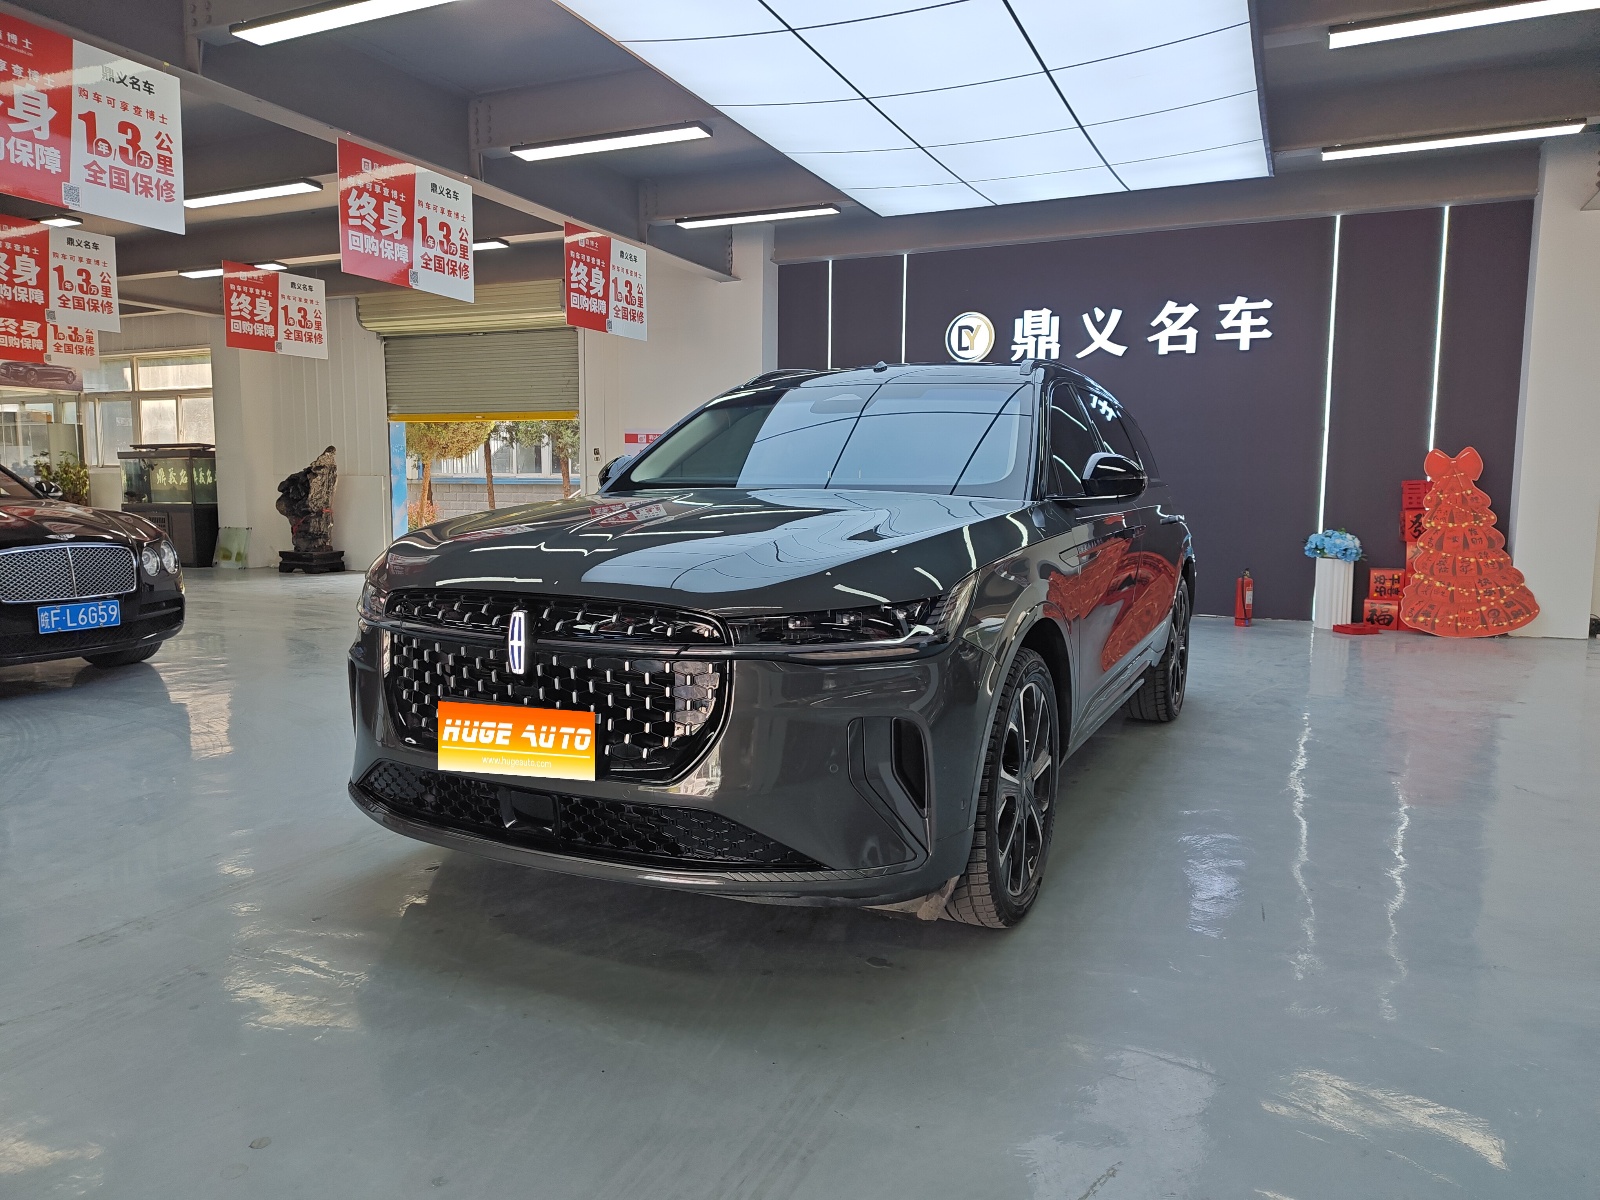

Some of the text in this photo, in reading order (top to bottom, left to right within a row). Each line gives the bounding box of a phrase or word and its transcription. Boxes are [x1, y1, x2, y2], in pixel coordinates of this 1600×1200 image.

[0, 83, 57, 141] 身
[78, 87, 168, 126] 购车可享查博士
[0, 135, 62, 175] 保障
[83, 160, 176, 203] 全国保修
[430, 182, 460, 201] 鼎义名车
[347, 189, 407, 240] 终身
[348, 229, 410, 264] 回购保障
[420, 252, 470, 280] 全国保修
[570, 259, 606, 298] 终身
[57, 294, 114, 315] 全国保修
[230, 292, 272, 322] 终身
[570, 292, 606, 316] 回购保障
[613, 304, 644, 324] 全国保修
[230, 318, 276, 338] 回购保障
[284, 328, 324, 344] 全国保修
[1010, 295, 1274, 362] 鼎义名车
[53, 342, 96, 357] 全国保修
